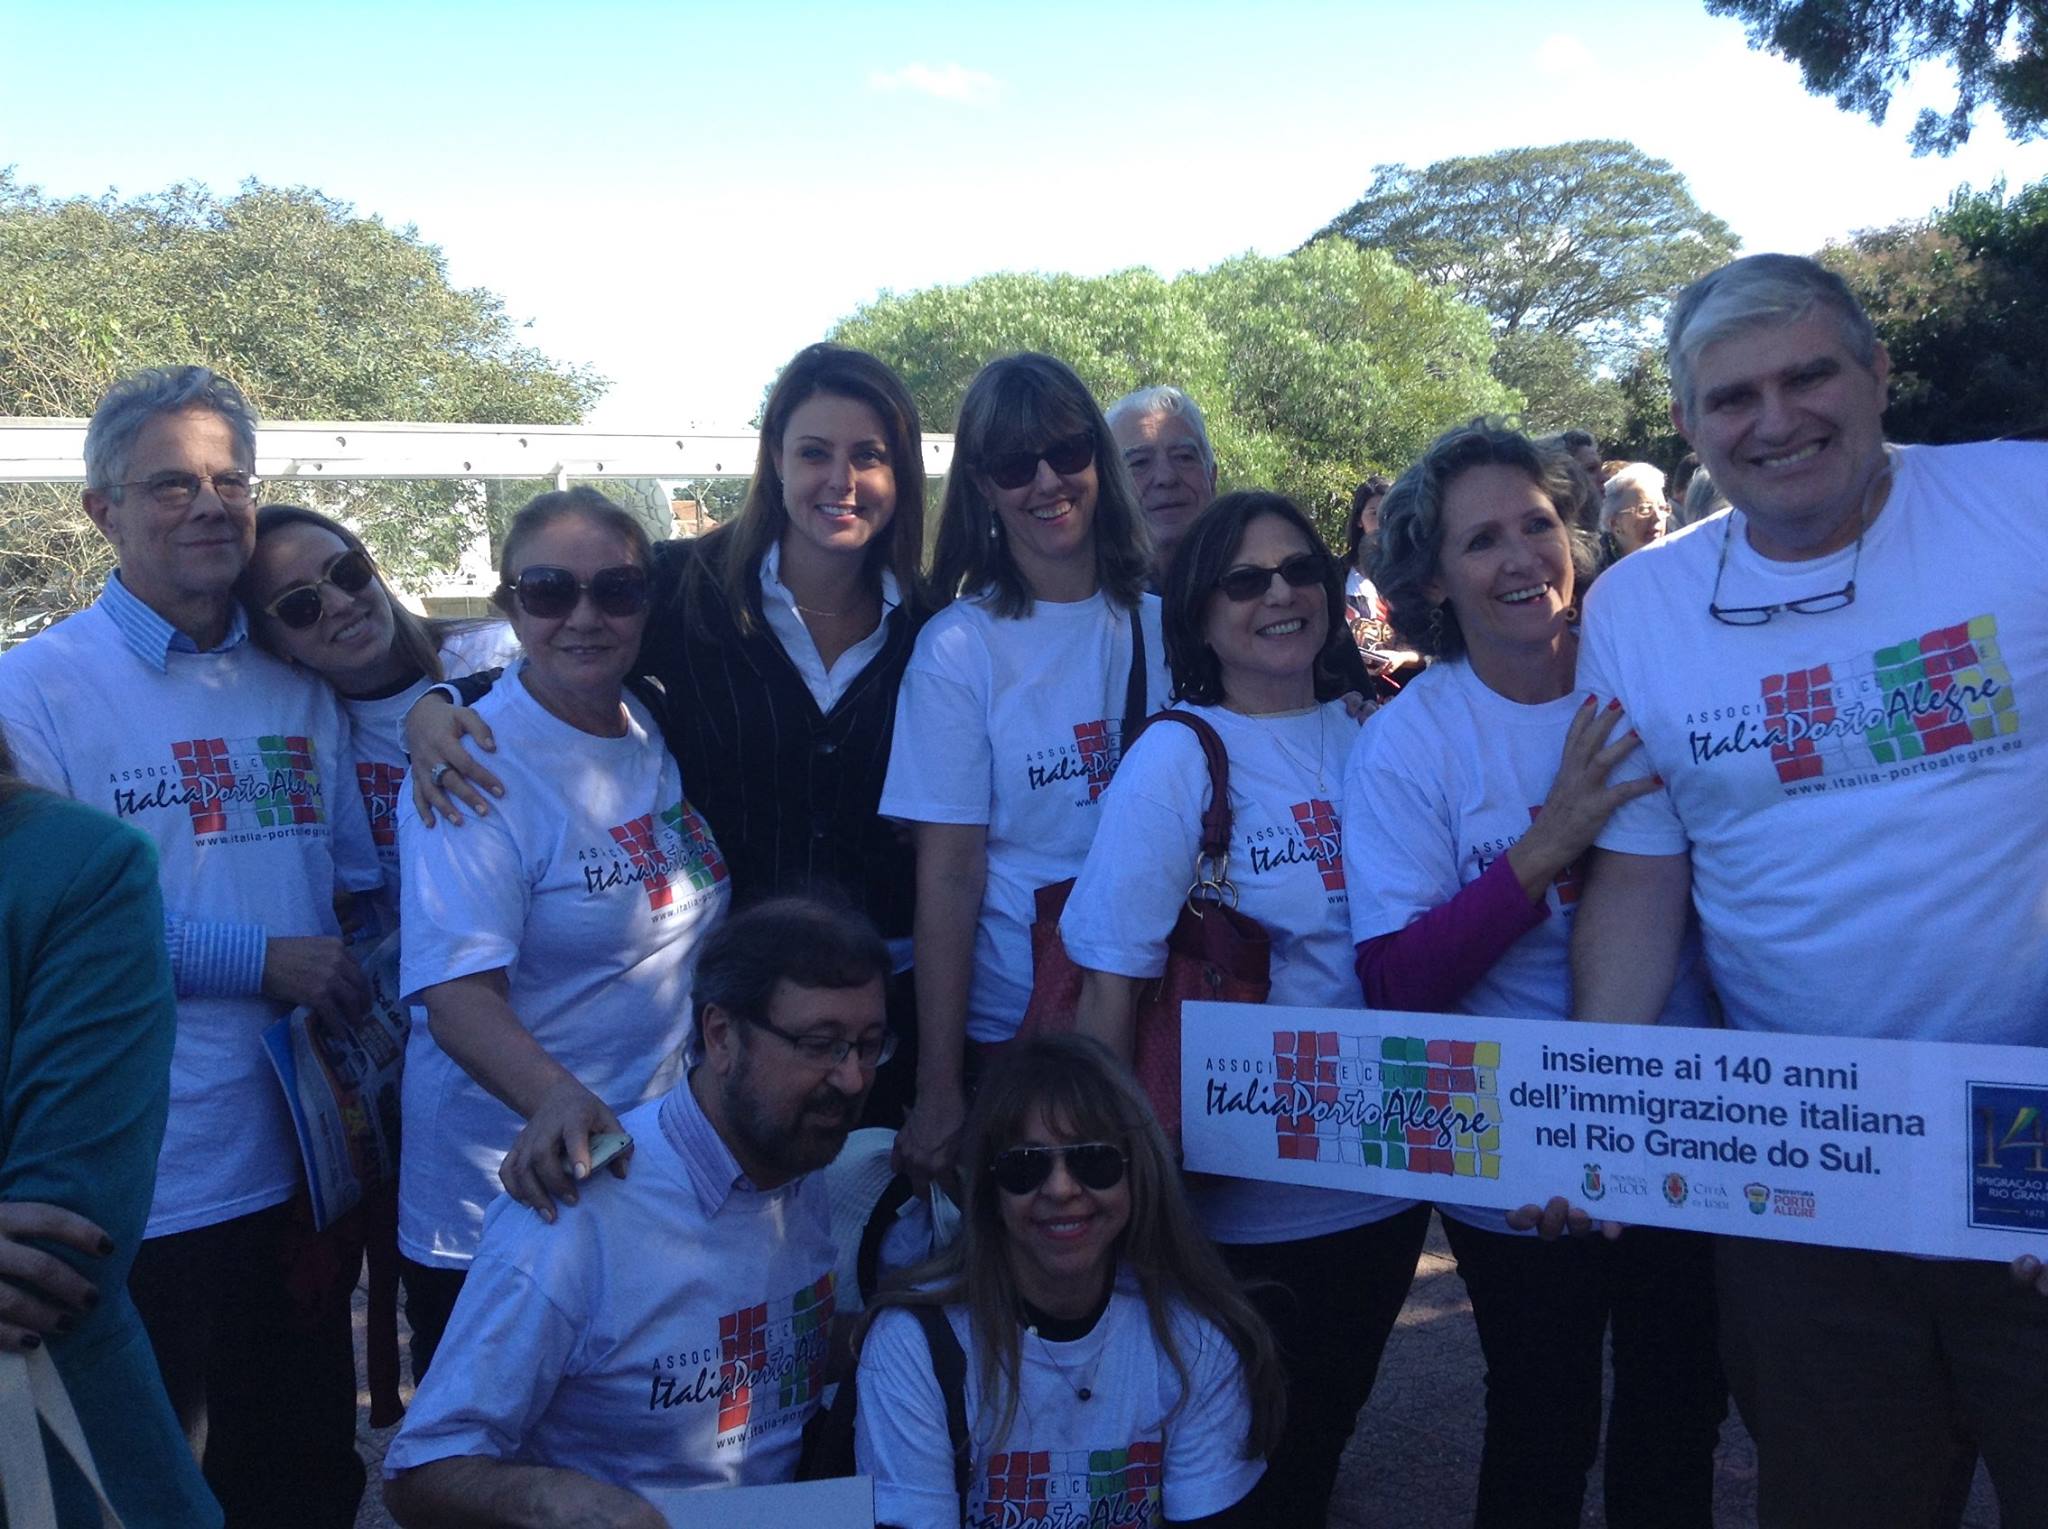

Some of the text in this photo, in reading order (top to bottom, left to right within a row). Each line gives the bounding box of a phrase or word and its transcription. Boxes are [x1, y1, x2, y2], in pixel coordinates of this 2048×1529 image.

[1541, 1045, 1858, 1090] insieme ai 140 anni
[1205, 1077, 1491, 1149] ItaliaPortoAlegre
[1509, 1081, 1926, 1137] dell'immigrazione italiana
[1536, 1122, 1881, 1175] nel Rio Grande do Sul.
[1773, 1195, 1816, 1208] PORTO
[1773, 1205, 1816, 1218] ALEGRE
